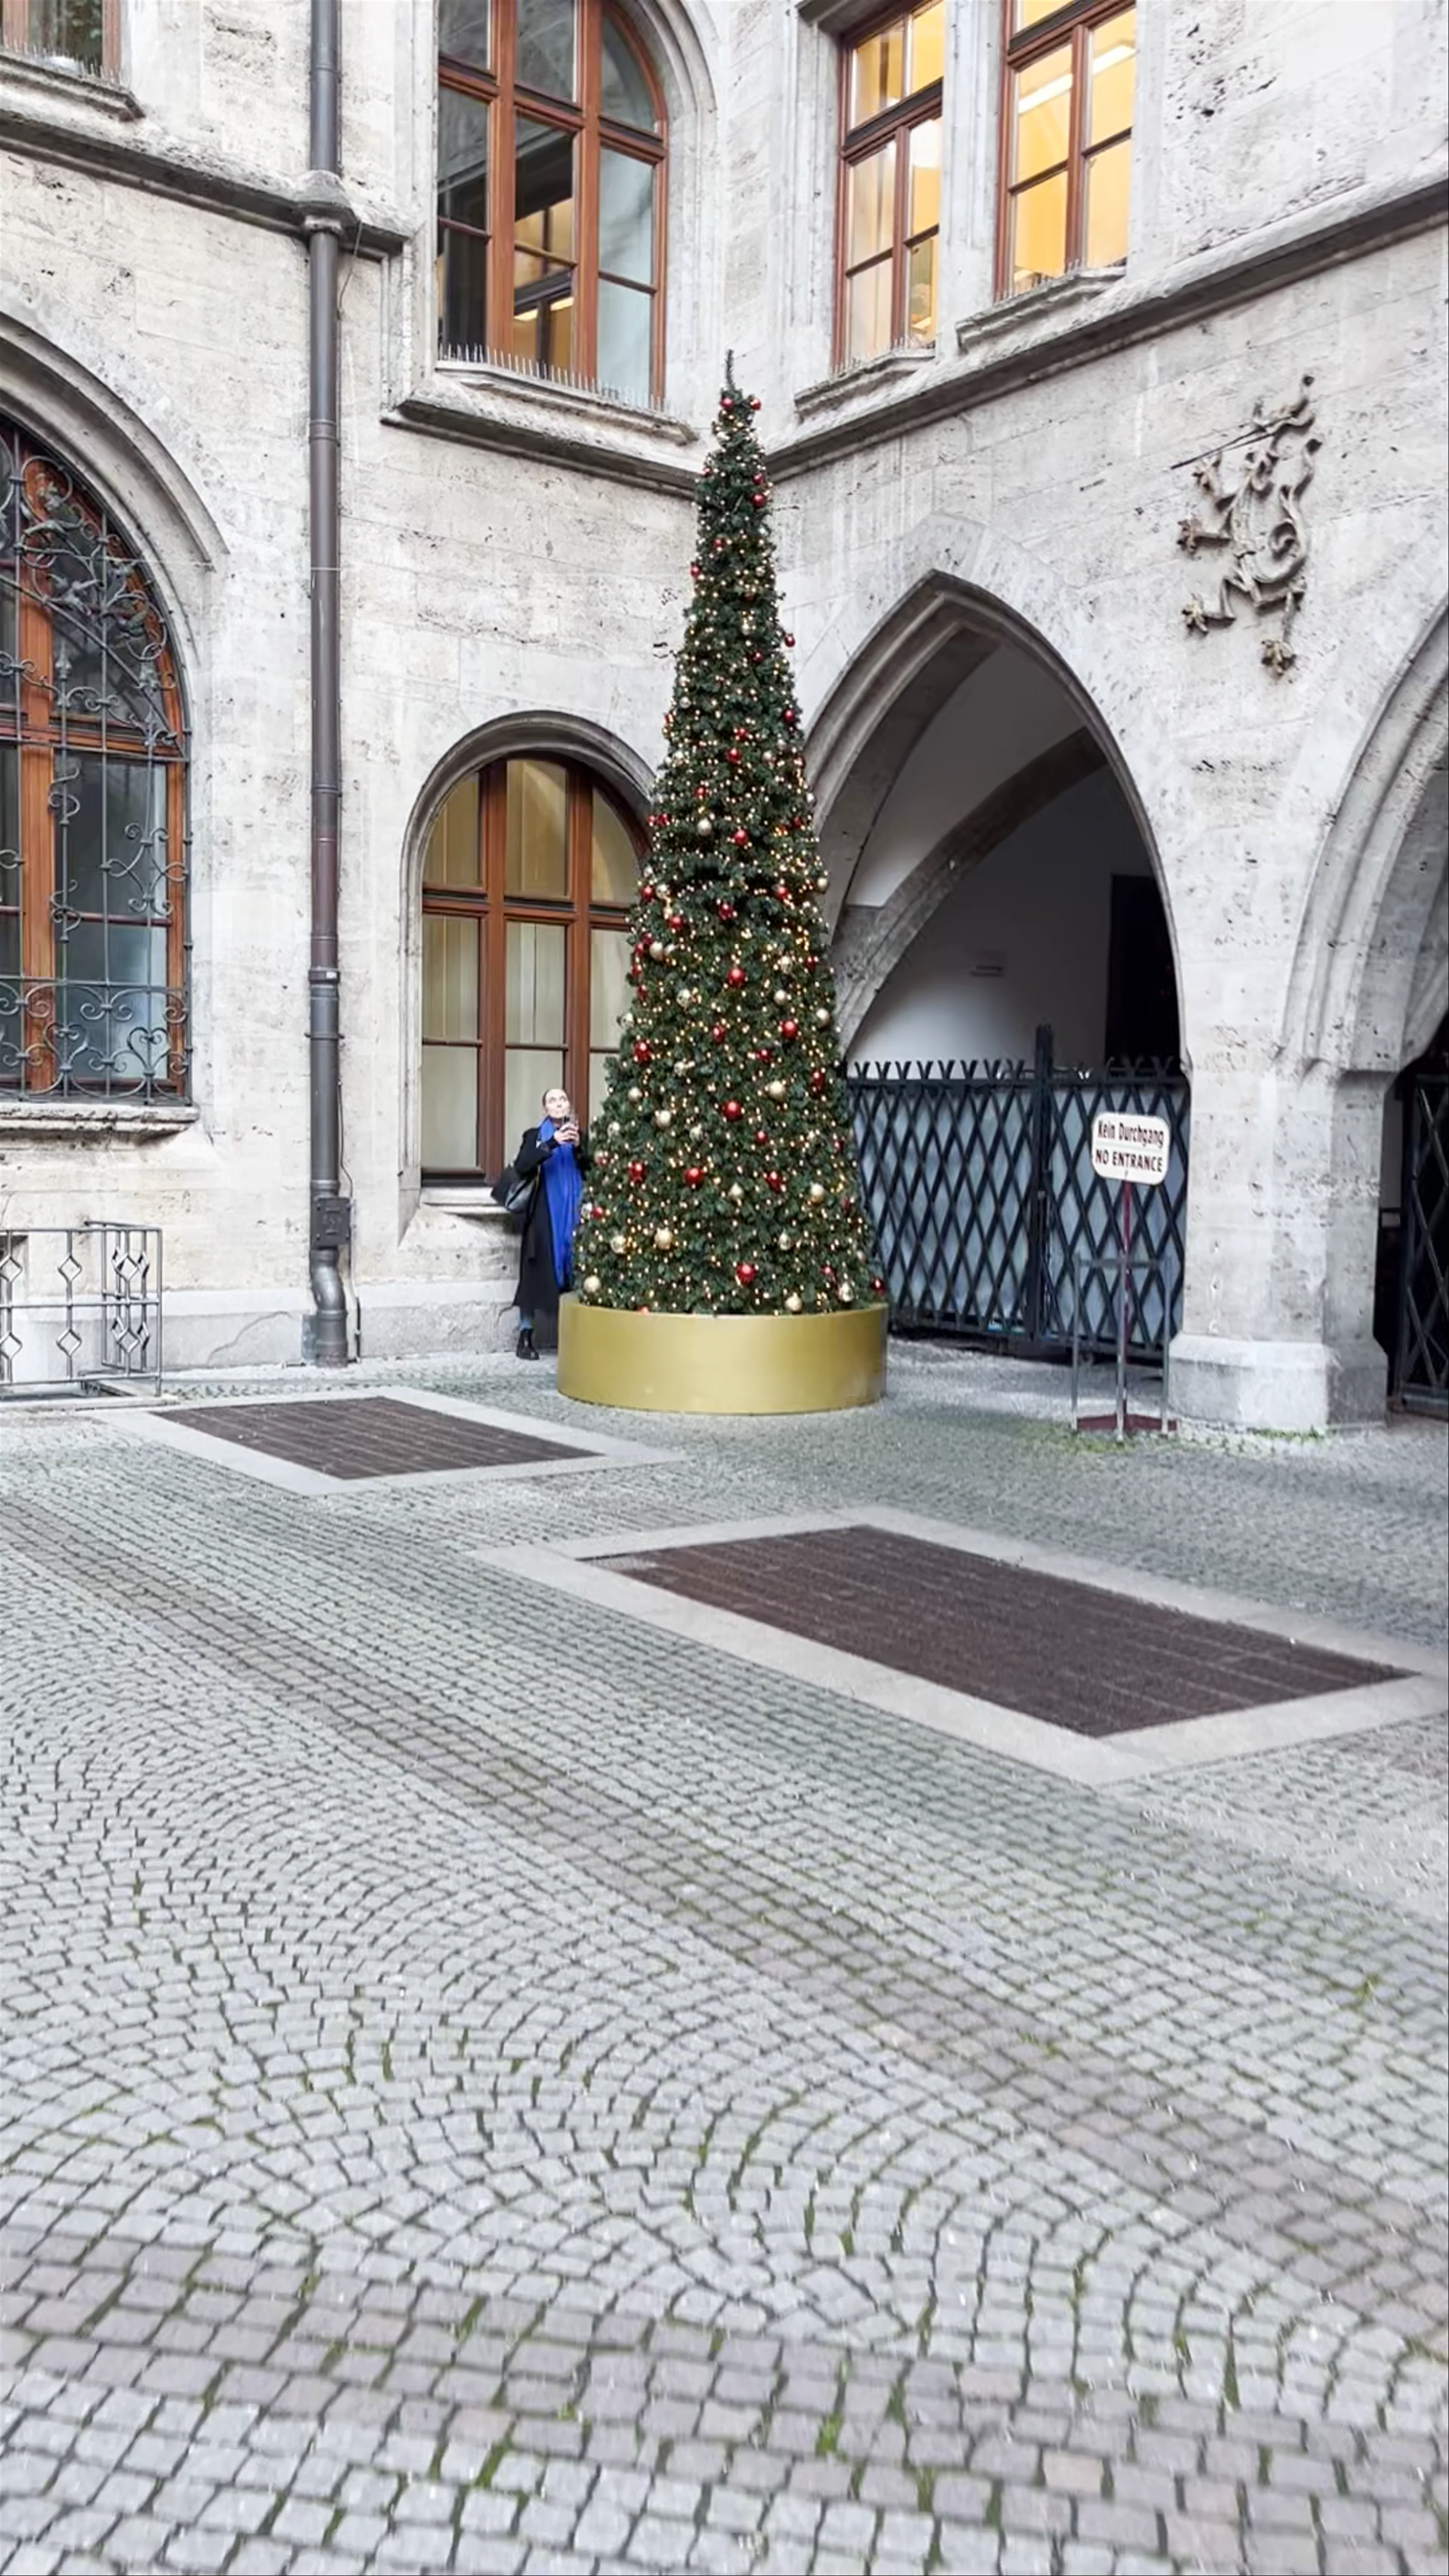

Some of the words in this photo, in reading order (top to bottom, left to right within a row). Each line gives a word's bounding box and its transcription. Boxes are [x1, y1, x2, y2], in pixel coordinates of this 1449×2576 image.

[1098, 1121, 1115, 1139] Kein
[1119, 1122, 1164, 1149] Durchgang
[1095, 1149, 1109, 1165] NO
[1113, 1151, 1163, 1172] ENTRANCE
